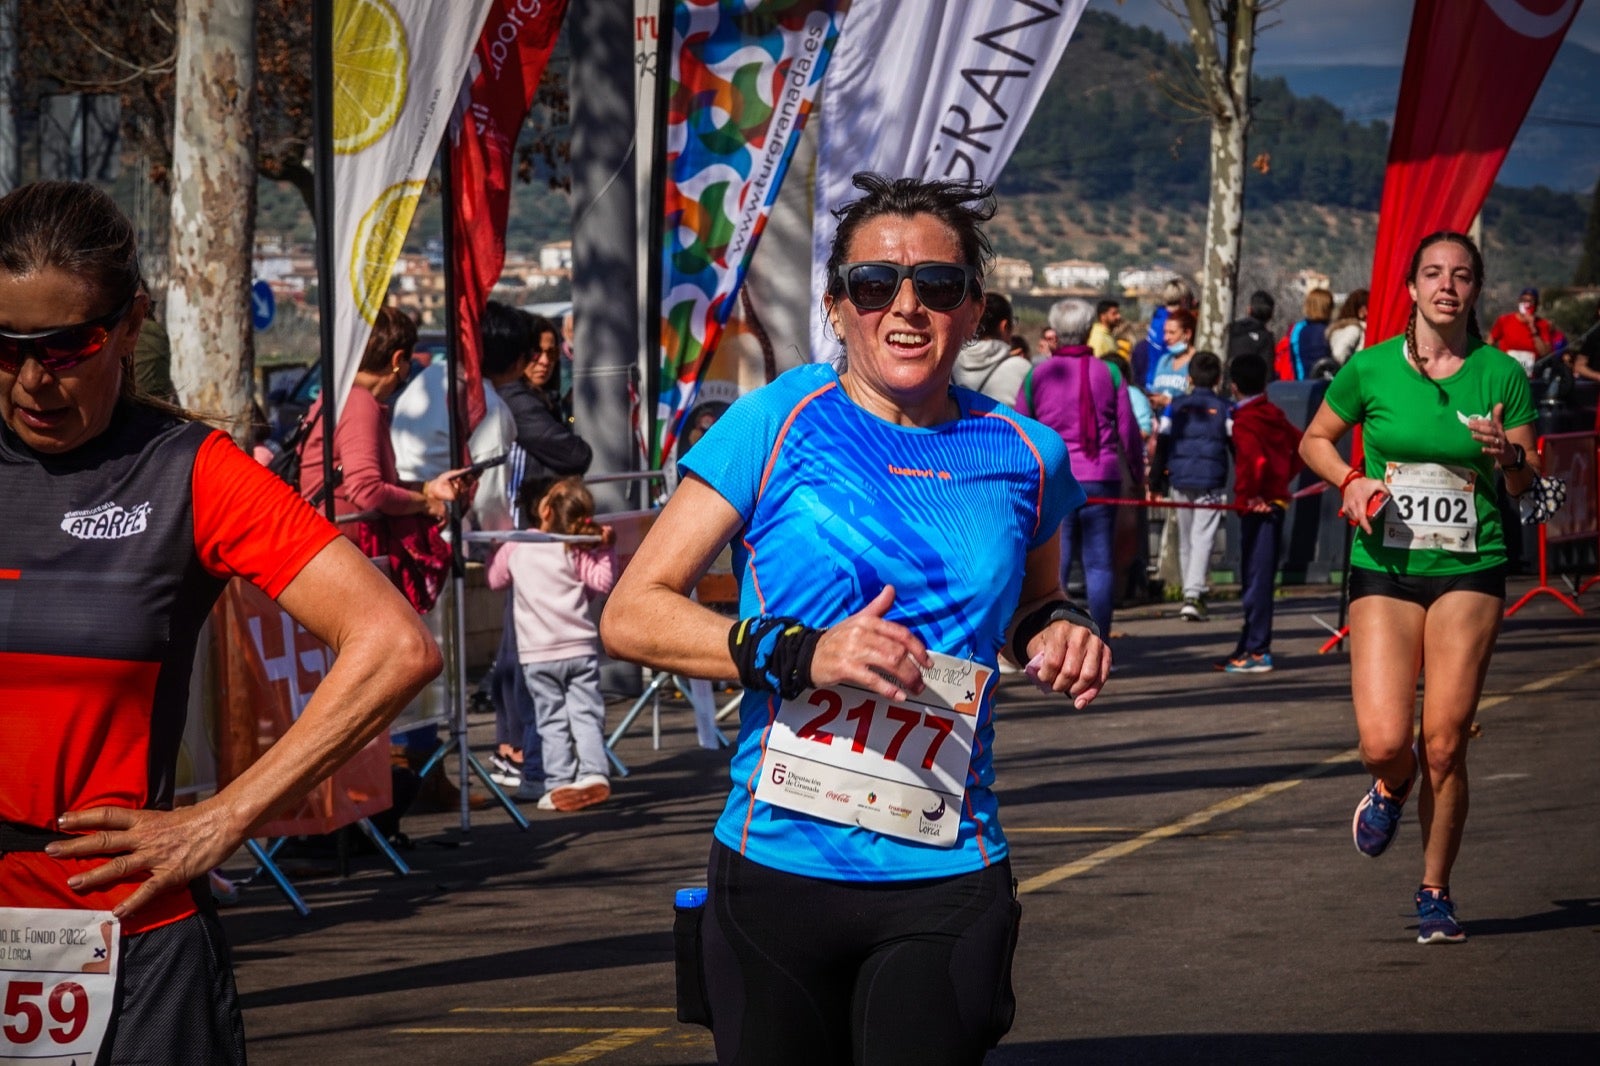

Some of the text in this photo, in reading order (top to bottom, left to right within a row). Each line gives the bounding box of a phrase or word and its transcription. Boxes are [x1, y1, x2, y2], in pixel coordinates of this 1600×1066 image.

[732, 26, 822, 254] www.turgranada.es
[70, 506, 145, 537] ATARFE
[1397, 495, 1468, 524] 3102
[921, 667, 942, 682] ONDO
[942, 668, 965, 687] 2022
[796, 689, 954, 771] 2177
[788, 771, 821, 786] Diputación
[794, 781, 820, 793] Granada
[919, 815, 940, 837] Lorca
[10, 929, 21, 944] DE
[59, 928, 87, 946] 2022
[3, 980, 90, 1045] 59
